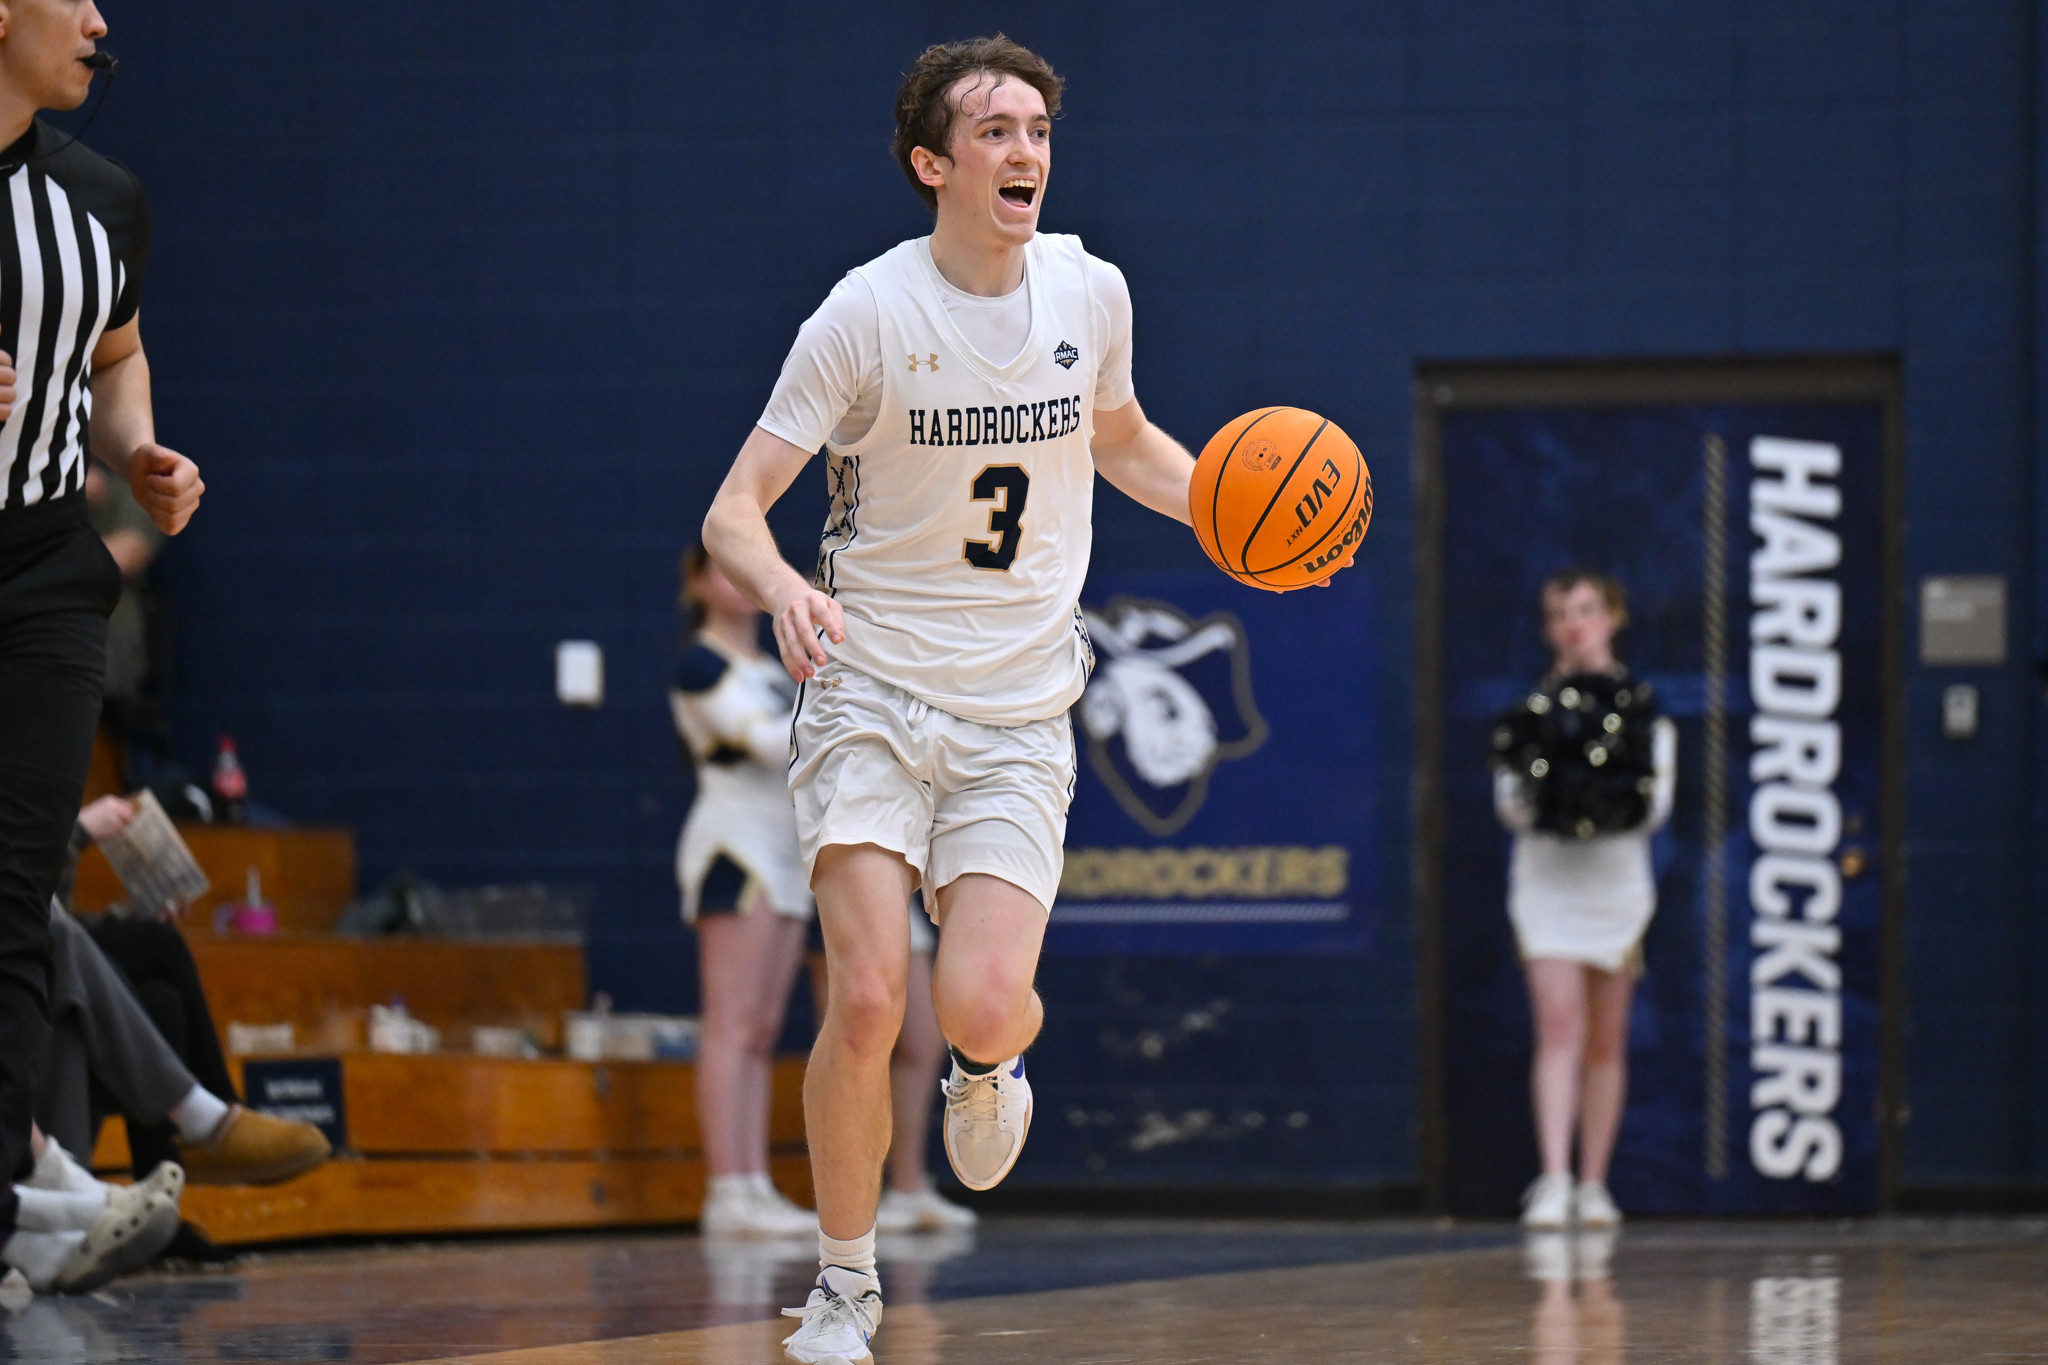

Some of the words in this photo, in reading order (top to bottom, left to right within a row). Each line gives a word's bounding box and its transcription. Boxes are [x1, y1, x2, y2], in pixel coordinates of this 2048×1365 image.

[1055, 349, 1078, 362] RMAC
[909, 395, 1081, 446] HARDROCKERS
[961, 463, 1031, 572] 3
[1295, 458, 1341, 528] EVO
[1303, 476, 1373, 573] Wilson
[1286, 526, 1304, 548] NXT
[1750, 434, 1843, 1183] HARDROCKERS
